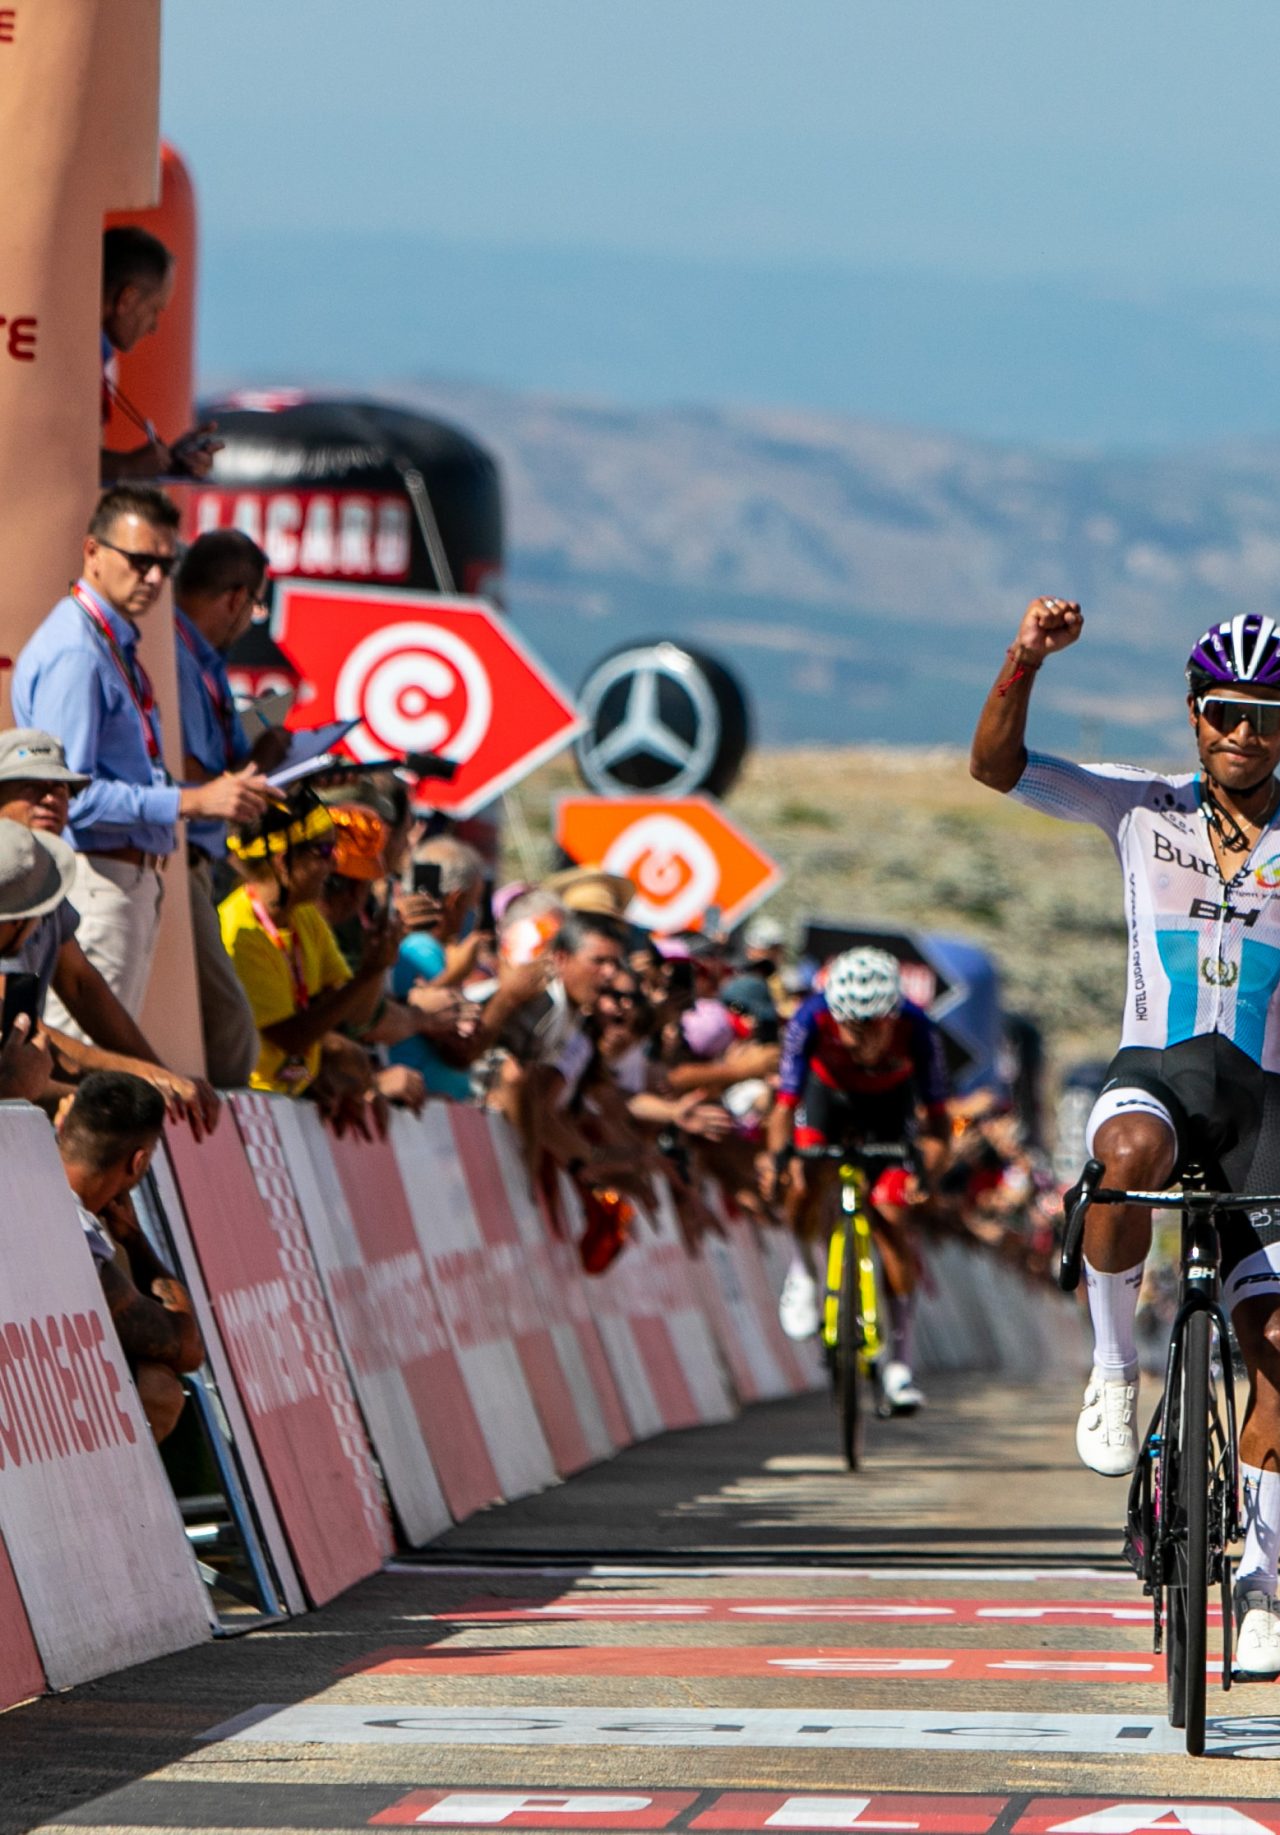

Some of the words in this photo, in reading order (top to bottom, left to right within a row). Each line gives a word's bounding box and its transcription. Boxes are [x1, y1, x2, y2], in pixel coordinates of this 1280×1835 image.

[1189, 898, 1261, 928] BH
[1136, 990, 1148, 1022] HOTEL
[1188, 1265, 1216, 1280] BH
